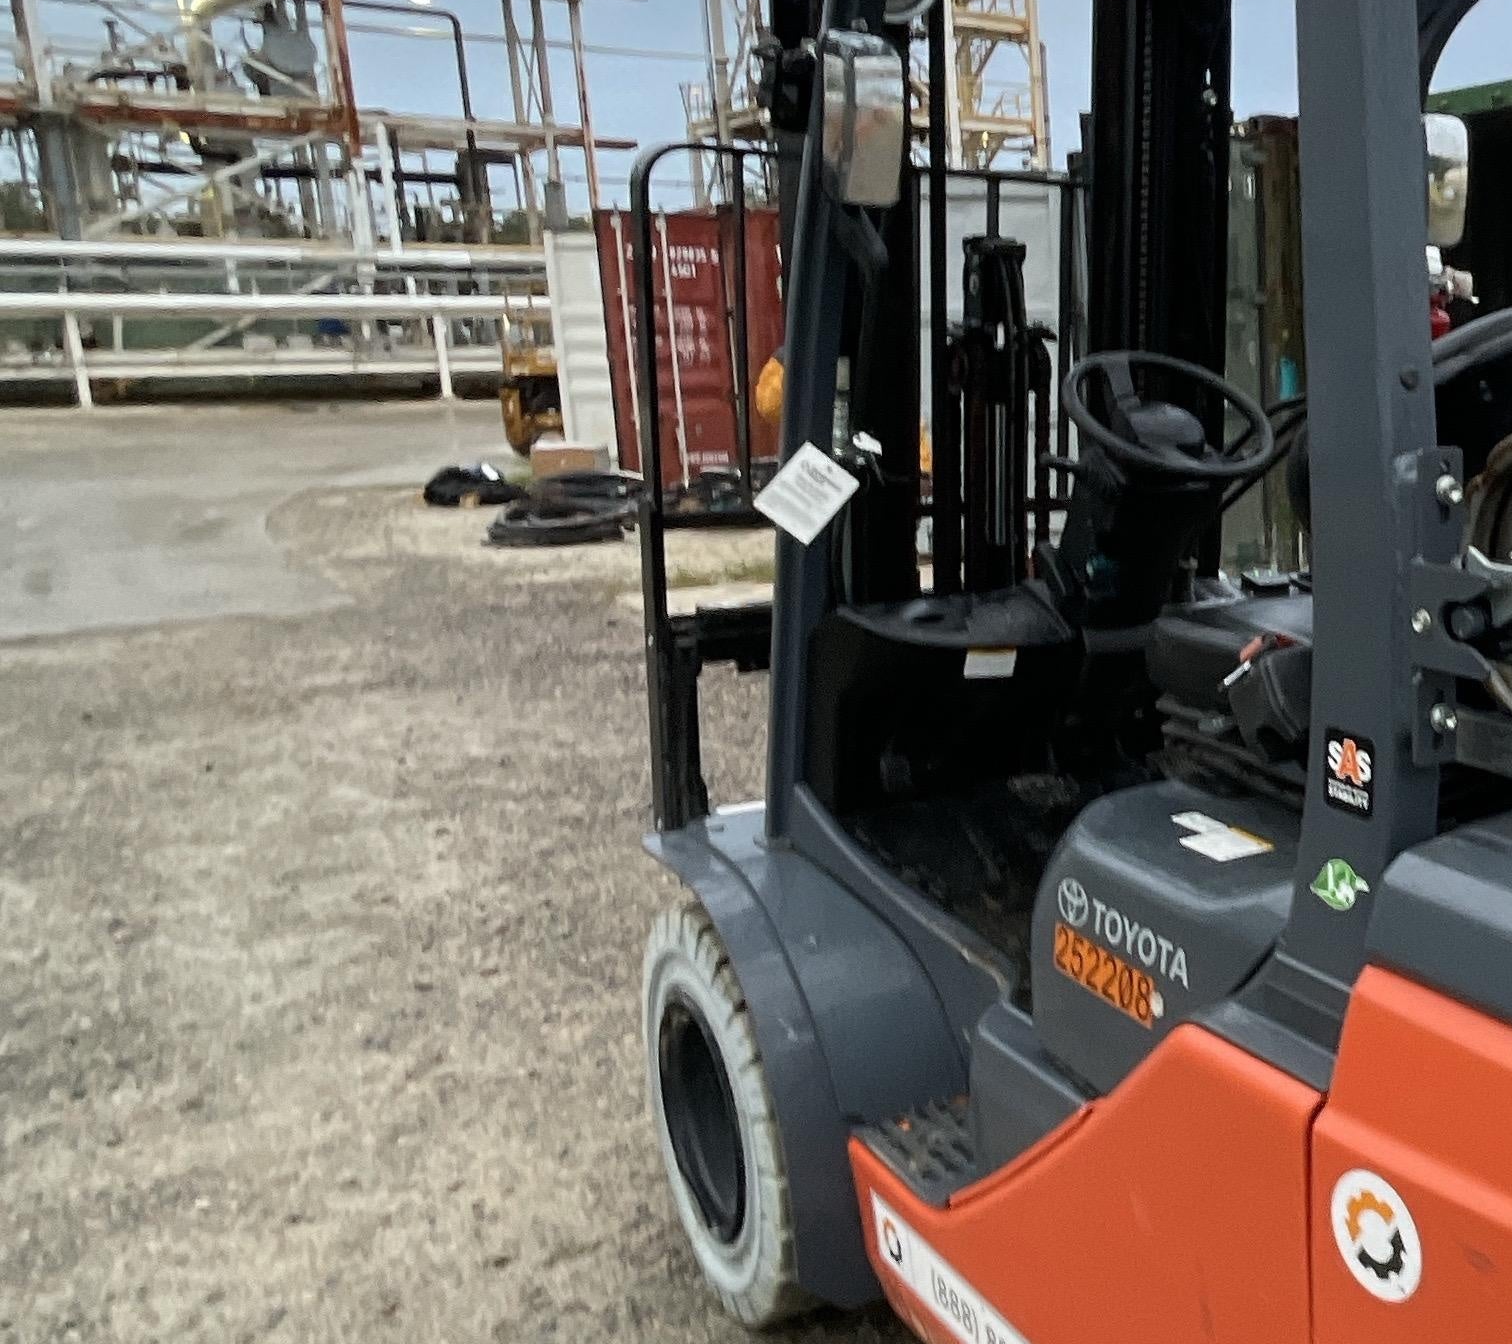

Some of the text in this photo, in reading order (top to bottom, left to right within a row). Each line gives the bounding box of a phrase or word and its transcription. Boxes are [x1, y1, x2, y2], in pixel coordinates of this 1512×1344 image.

[1327, 738, 1371, 786] SAS
[1056, 925, 1150, 1022] 252208
[1092, 897, 1189, 992] TOYOTA
